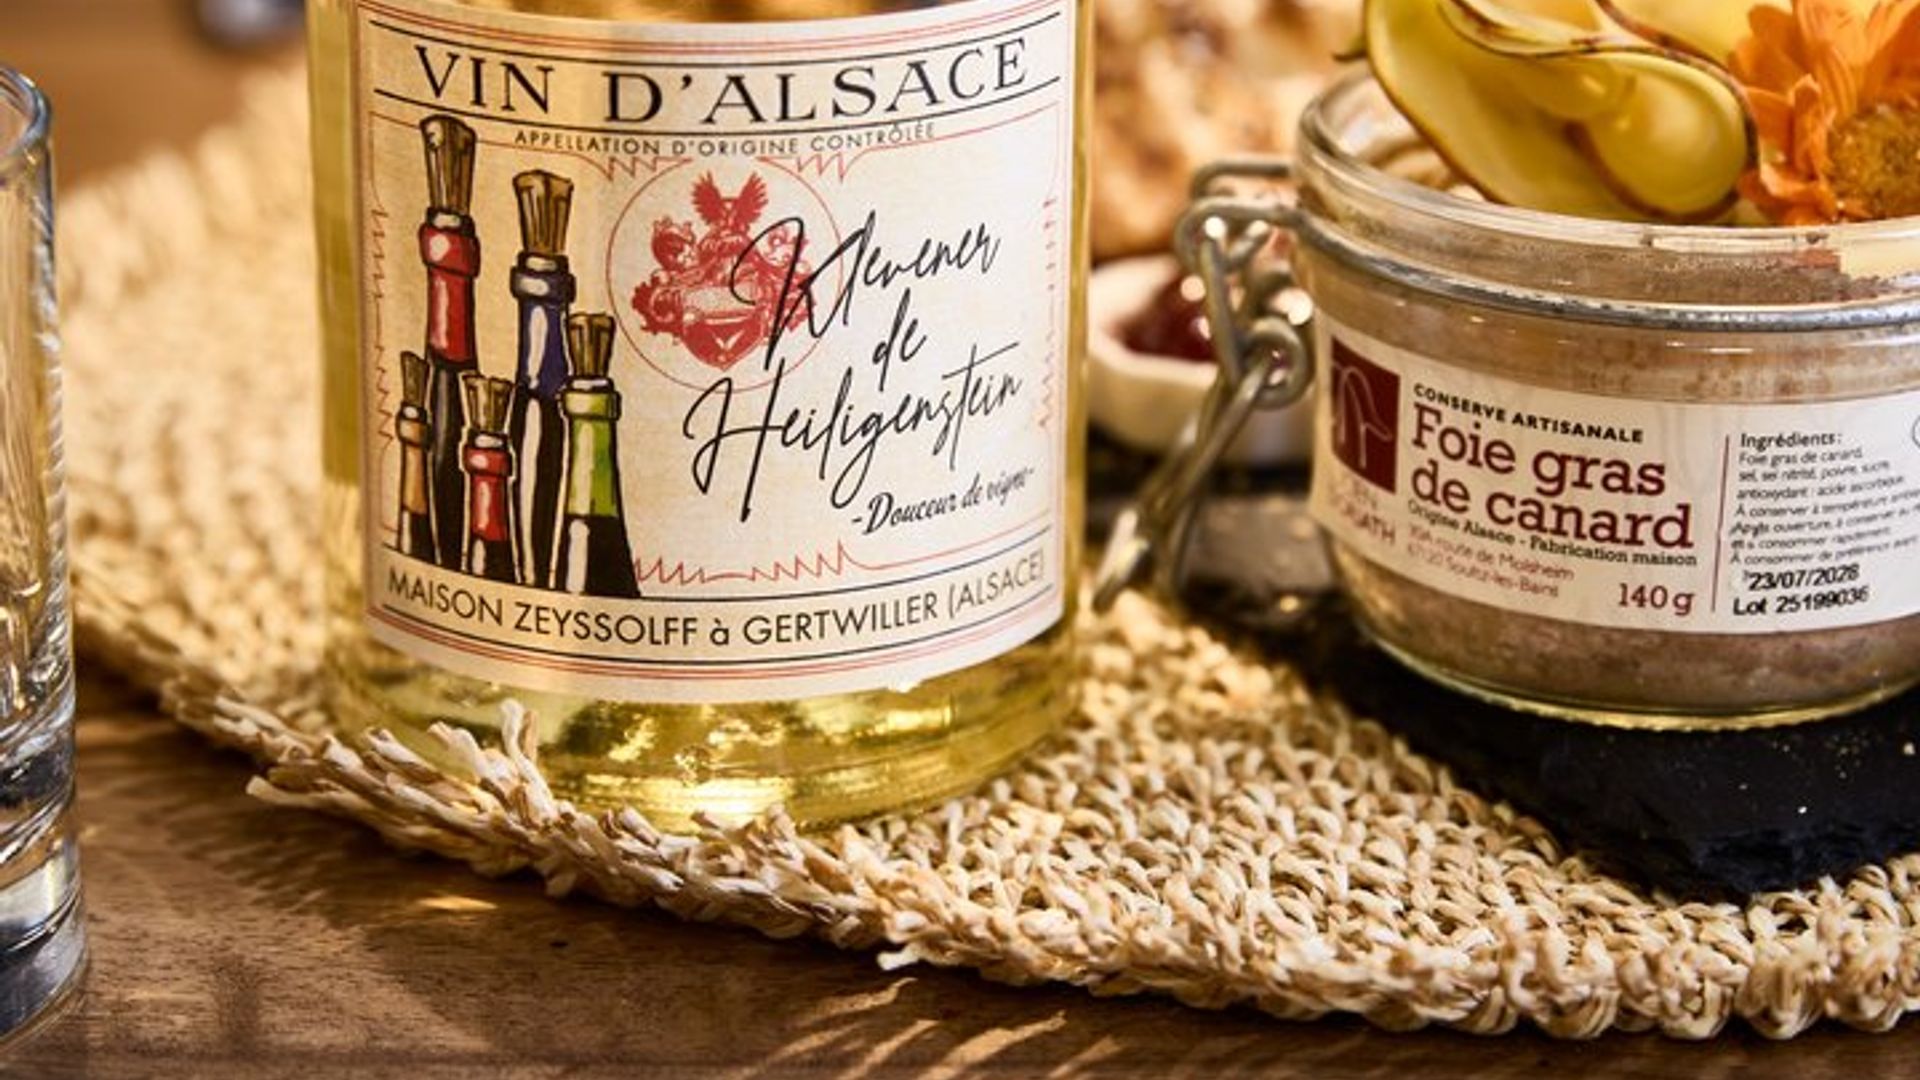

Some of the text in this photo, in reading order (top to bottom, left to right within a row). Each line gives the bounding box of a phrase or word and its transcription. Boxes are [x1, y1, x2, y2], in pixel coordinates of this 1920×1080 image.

[415, 45, 555, 114] VIN
[514, 130, 661, 156] APPELLATION
[810, 120, 936, 152] CONTRÔLÉE
[730, 210, 1000, 372] Klevener
[872, 287, 928, 392] de
[683, 341, 1023, 523] Heiligenstein
[1414, 383, 1644, 444] CONSERVE ARTISANALE
[1412, 401, 1666, 498] Foie gras
[1770, 453, 1797, 468] gras
[1800, 450, 1817, 464] de
[851, 490, 957, 536] -Douceur
[962, 472, 984, 510] de
[1411, 460, 1471, 514] de
[1485, 503, 1694, 548] canard
[1463, 520, 1516, 545] Alsace
[1529, 535, 1629, 563] Fabrication
[1632, 552, 1698, 567] maison
[1744, 552, 1816, 566] consommer
[387, 546, 1045, 647] MAISON ZEYSSOLFF à GERTWILLER (ALSACE)
[1733, 597, 1768, 616] Lot
[1748, 563, 1861, 592] 23/07/2028
